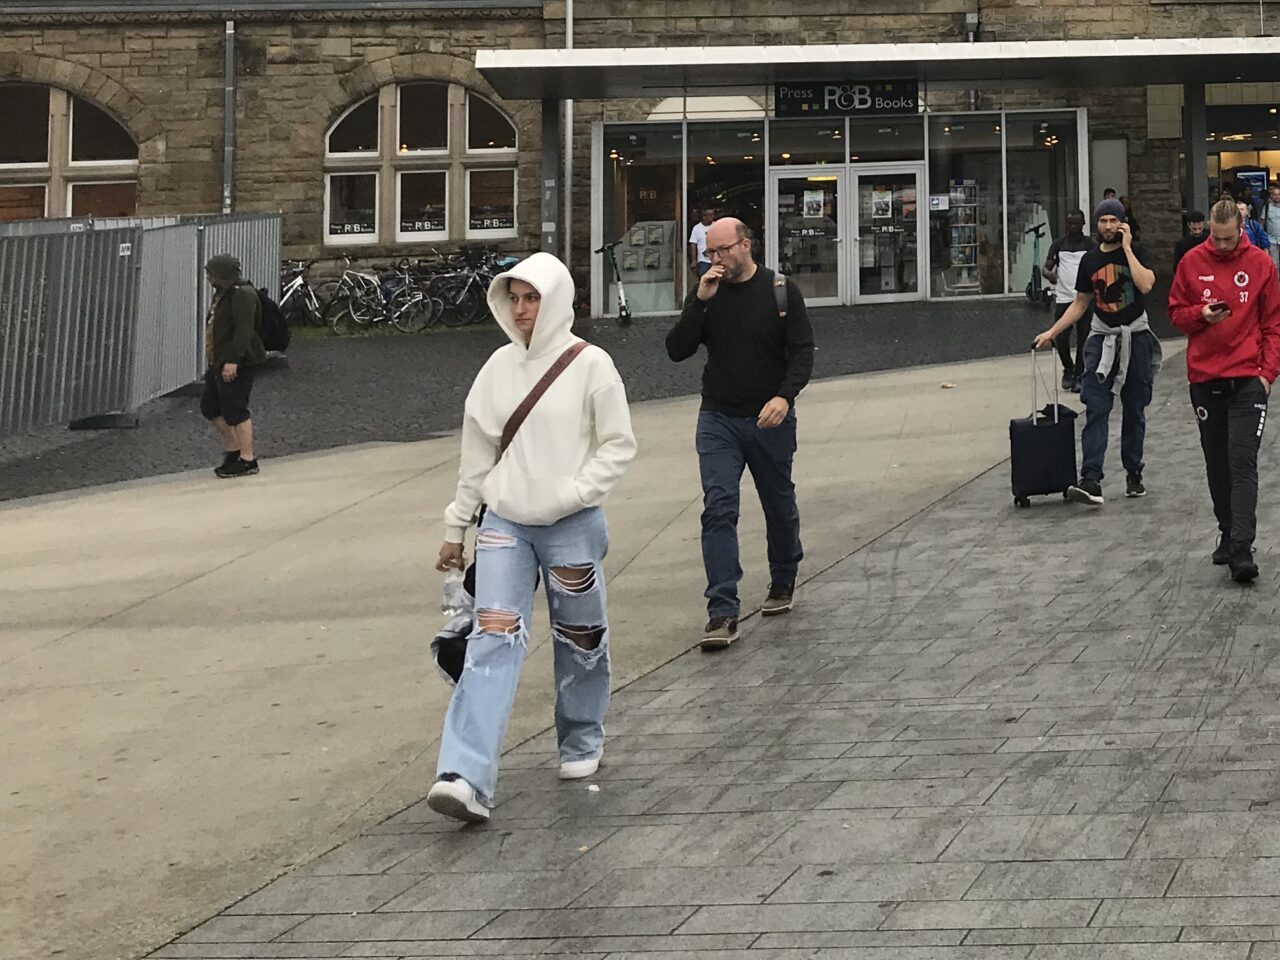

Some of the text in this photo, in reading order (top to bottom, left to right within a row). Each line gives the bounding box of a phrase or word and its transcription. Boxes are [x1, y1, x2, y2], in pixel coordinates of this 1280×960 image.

[779, 86, 814, 99] Press
[875, 96, 914, 109] Books
[1239, 291, 1249, 303] 37
